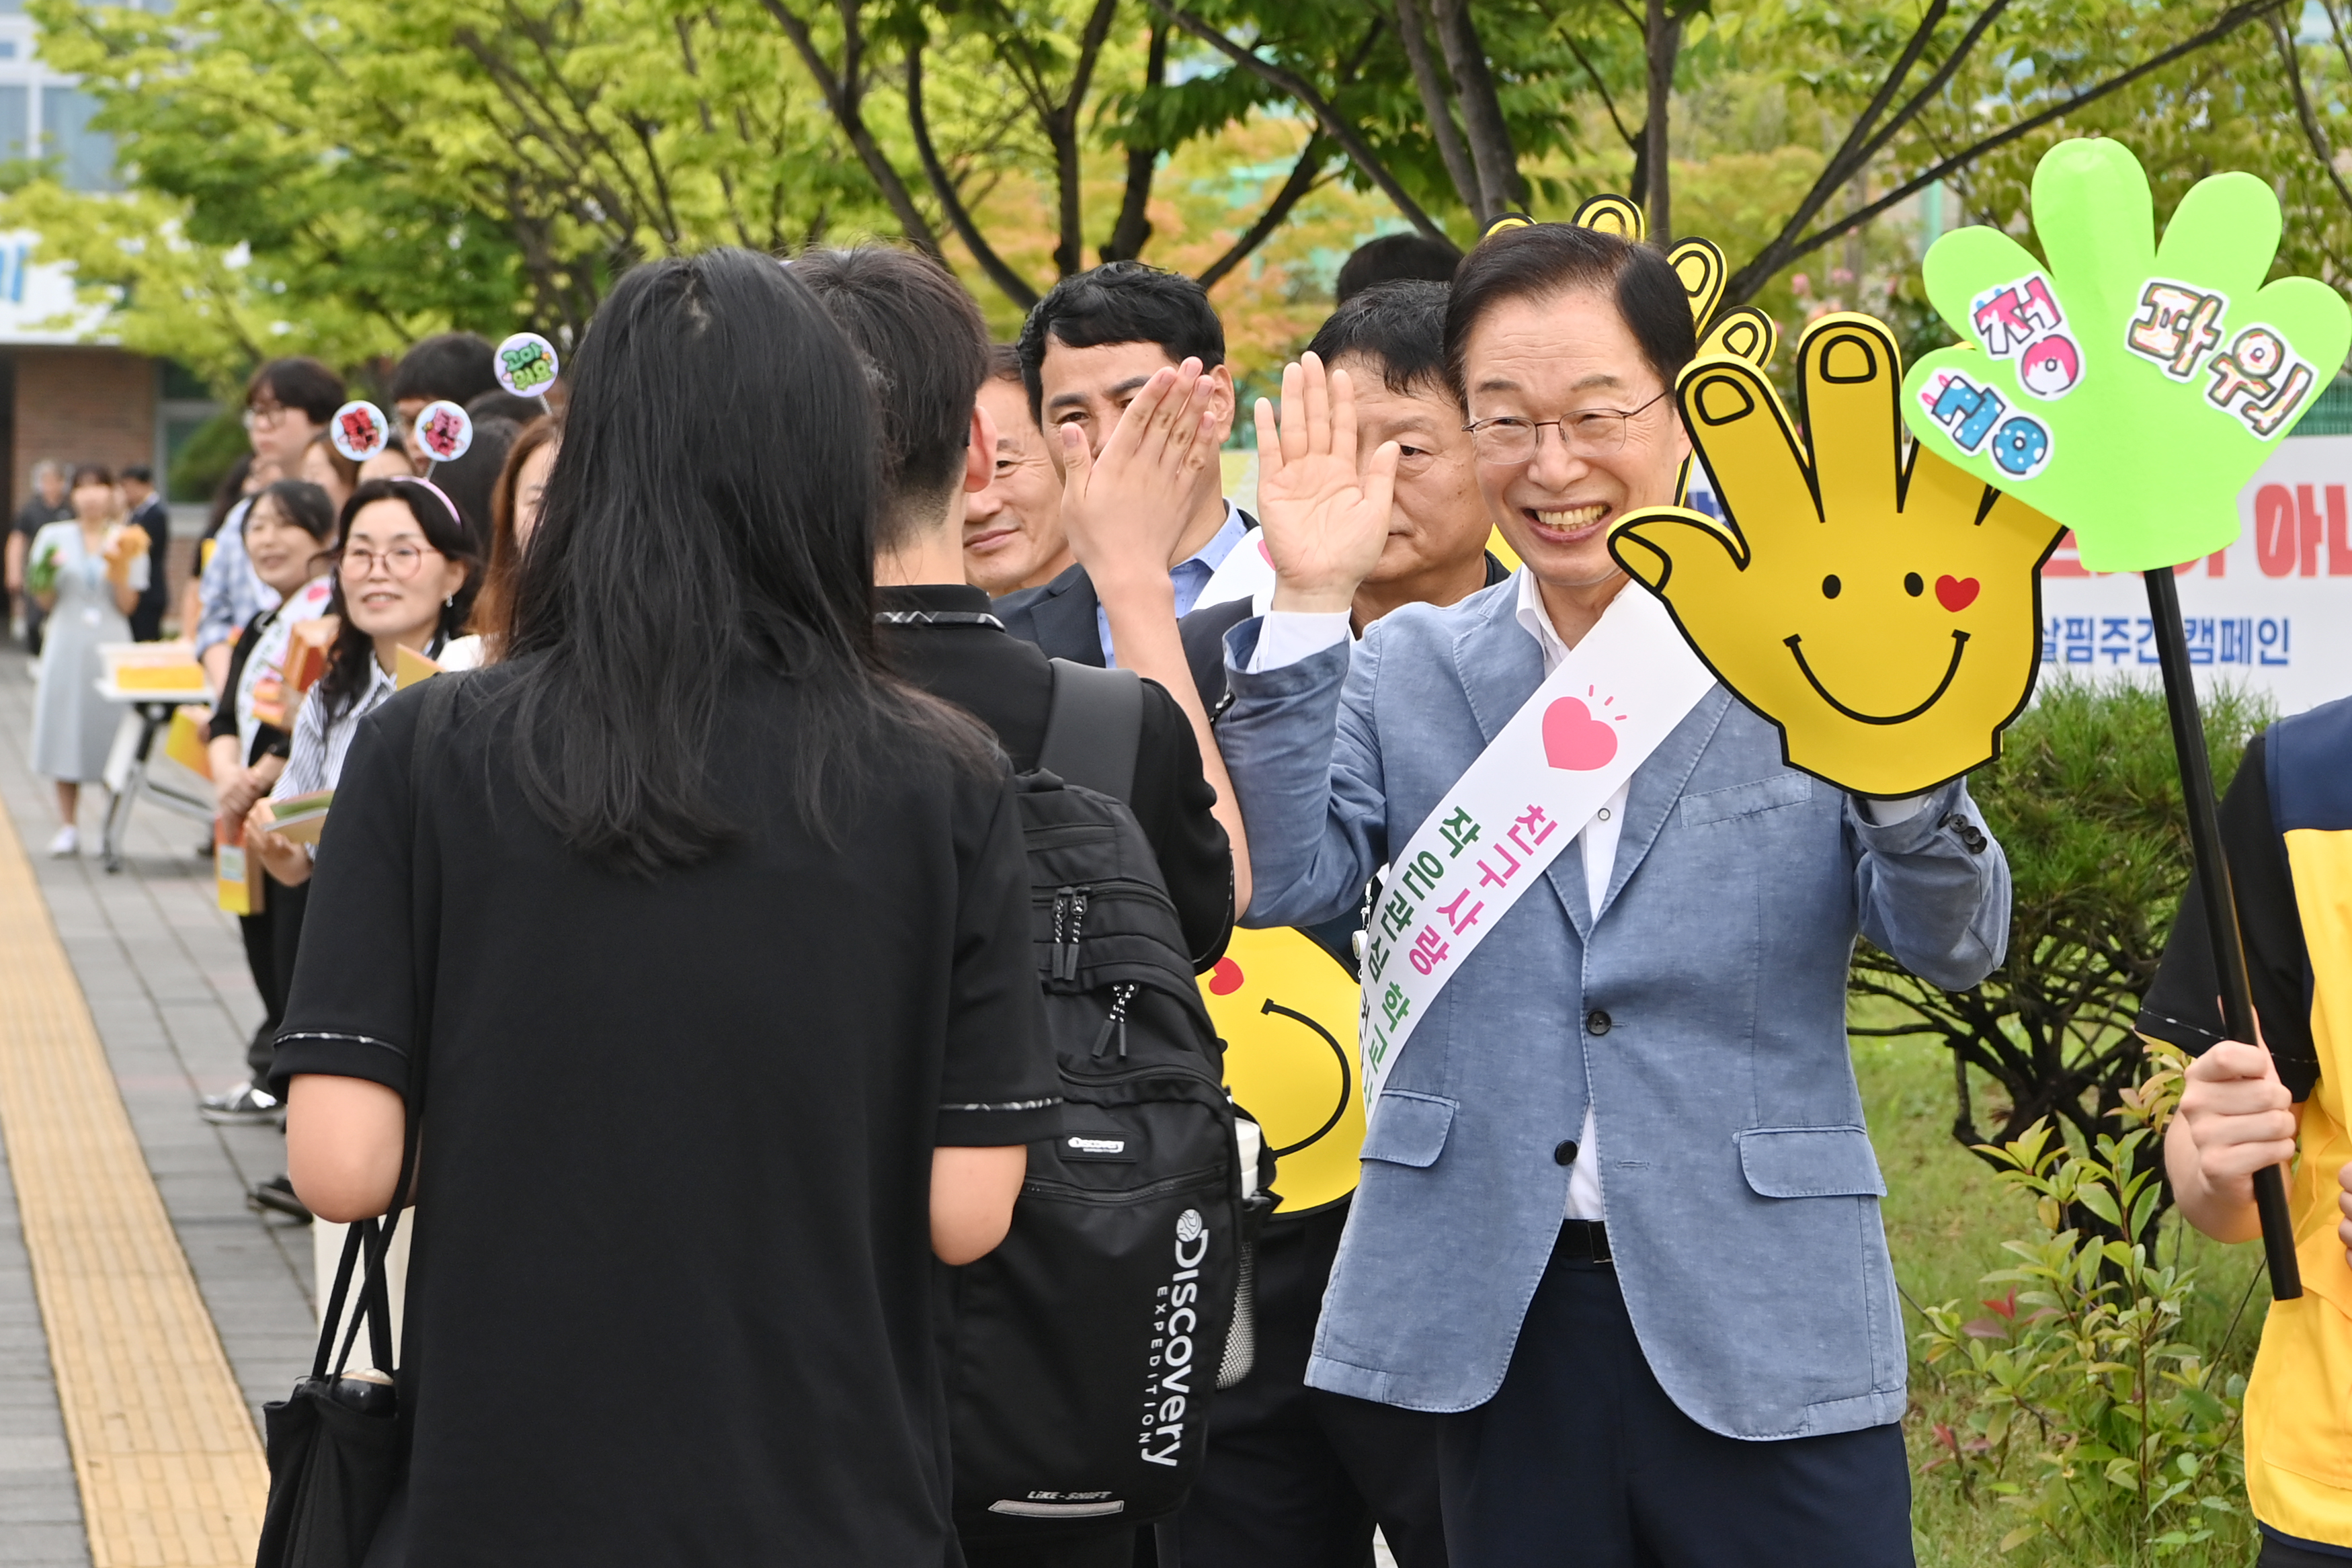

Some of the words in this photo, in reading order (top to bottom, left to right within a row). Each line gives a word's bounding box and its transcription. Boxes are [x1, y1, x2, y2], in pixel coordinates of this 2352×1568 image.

[2127, 282, 2314, 436] 파워
[2183, 617, 2290, 665] 캠페인
[1367, 805, 1482, 985] 작은관심
[1409, 804, 1558, 976] 친구사랑
[1138, 1285, 1169, 1444] EXPEDITION
